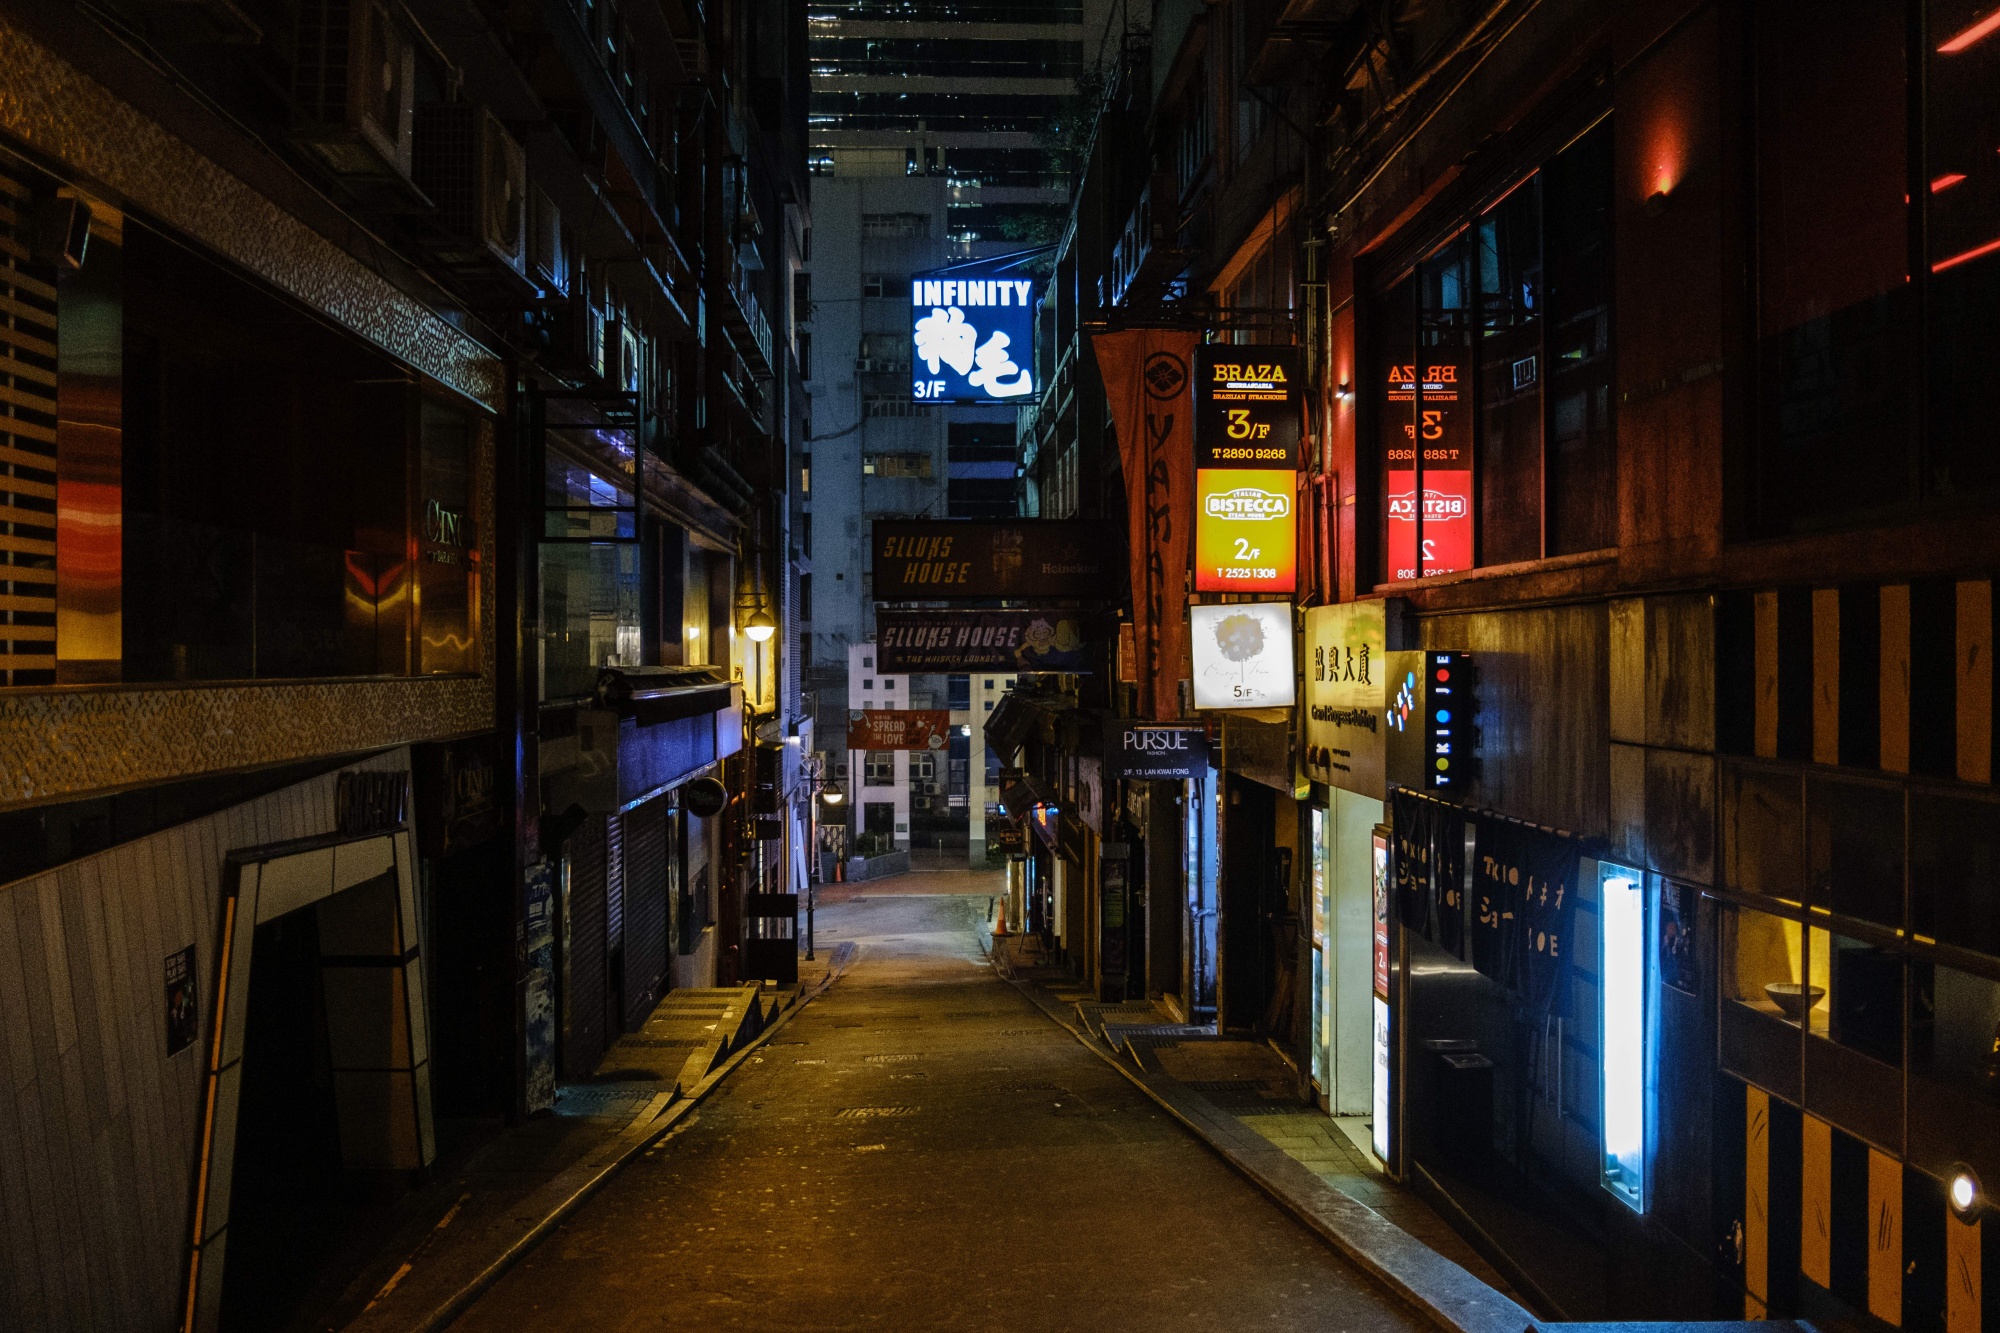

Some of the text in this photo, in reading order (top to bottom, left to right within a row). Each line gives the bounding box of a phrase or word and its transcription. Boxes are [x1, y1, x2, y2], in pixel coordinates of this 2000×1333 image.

[913, 281, 1032, 306] INFINITY
[1213, 364, 1288, 382] BRAZA
[1227, 409, 1271, 439] 3/F
[1255, 448, 1287, 460] 9268
[1233, 491, 1262, 499] ITALIAN
[1210, 498, 1285, 513] BISTECCA
[1234, 538, 1261, 561] 2/F
[903, 562, 971, 584] HOUSE
[1041, 563, 1098, 574] Heineken
[1217, 568, 1277, 579] T 2525 1308
[955, 626, 1020, 648] HOUSE
[906, 655, 996, 664] THE WHISKEY LOUNGE
[1233, 685, 1253, 698] 5/F
[873, 720, 905, 731] SPREAD
[883, 733, 904, 745] LOVE
[1124, 731, 1188, 750] PURSUE
[1144, 768, 1156, 776] LAN
[1157, 768, 1172, 776] KWAI
[1173, 767, 1189, 775] FONG
